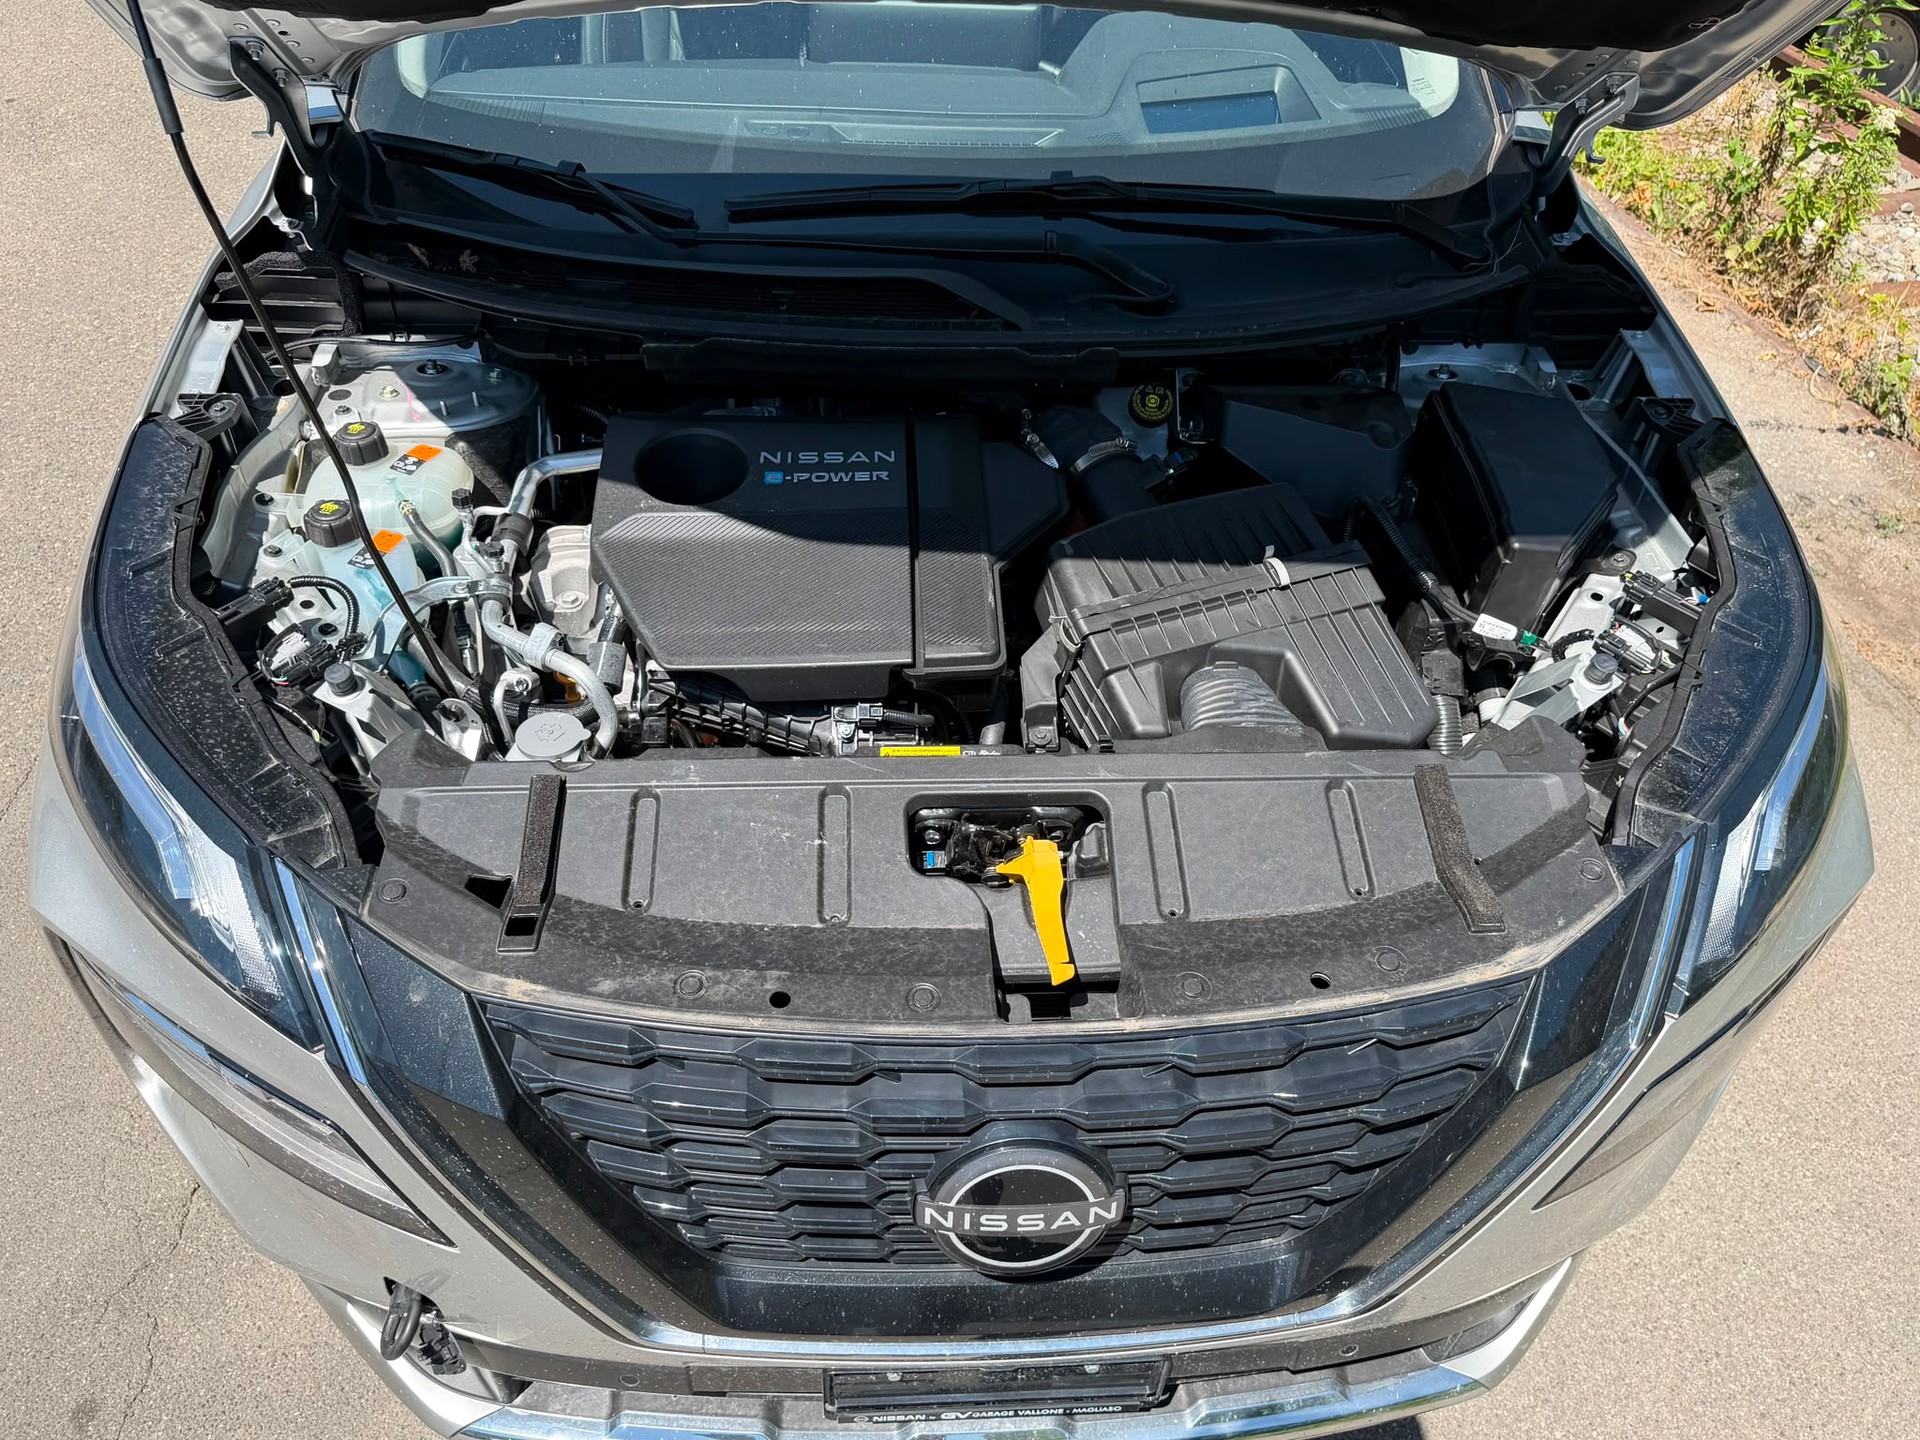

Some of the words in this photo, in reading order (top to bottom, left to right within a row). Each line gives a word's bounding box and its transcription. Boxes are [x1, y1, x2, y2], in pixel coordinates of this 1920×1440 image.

[759, 450, 896, 465] NISSAN
[764, 470, 890, 485] e-POWER
[924, 1201, 1118, 1232] NISSAN
[872, 1414, 926, 1422] NISSAN
[940, 1411, 972, 1420] GV
[972, 1410, 1014, 1418] GARAGE
[1018, 1408, 1064, 1416] VALLONE
[1072, 1405, 1122, 1414] MAGLIASO
